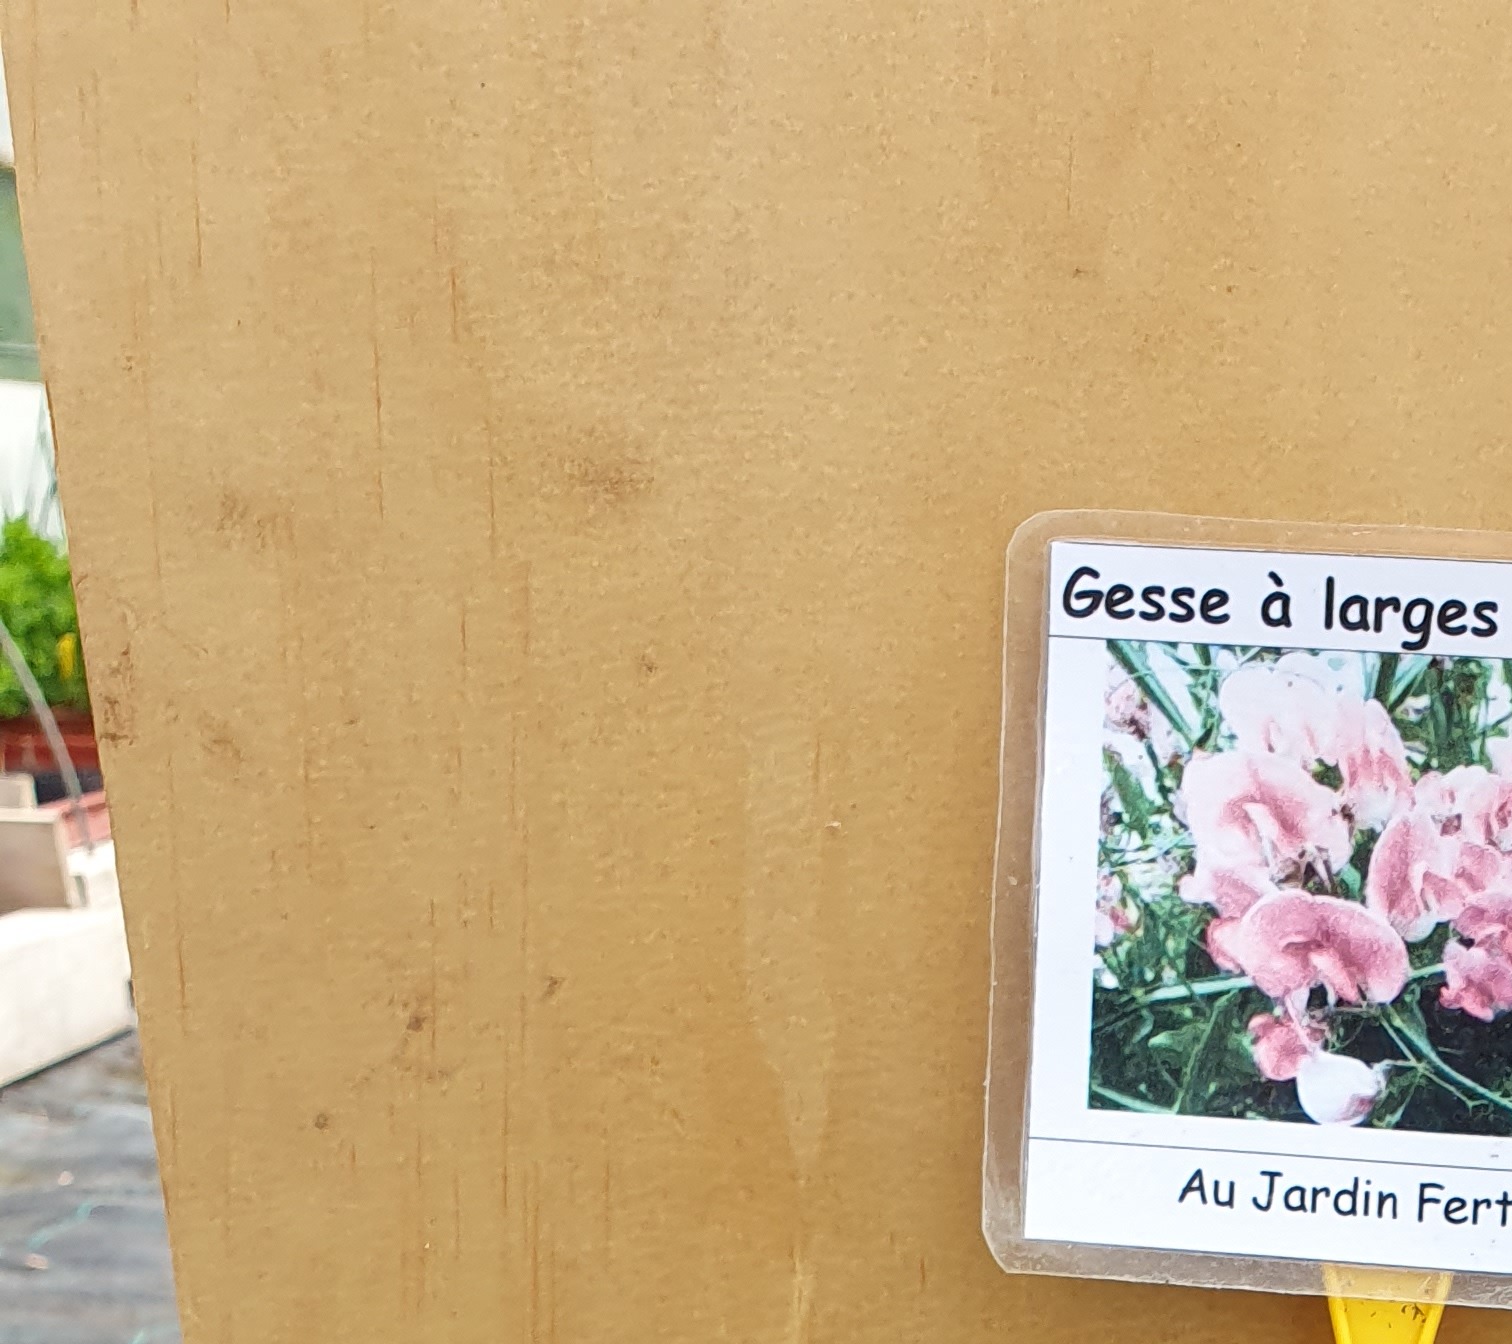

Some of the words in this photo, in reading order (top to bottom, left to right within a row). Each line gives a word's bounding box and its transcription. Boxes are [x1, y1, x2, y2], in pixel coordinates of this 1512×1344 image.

[1062, 566, 1231, 625] Gesse
[1260, 570, 1292, 628] à
[1324, 575, 1498, 650] larges
[1178, 1168, 1235, 1209] Au
[1252, 1170, 1397, 1220] Jardin
